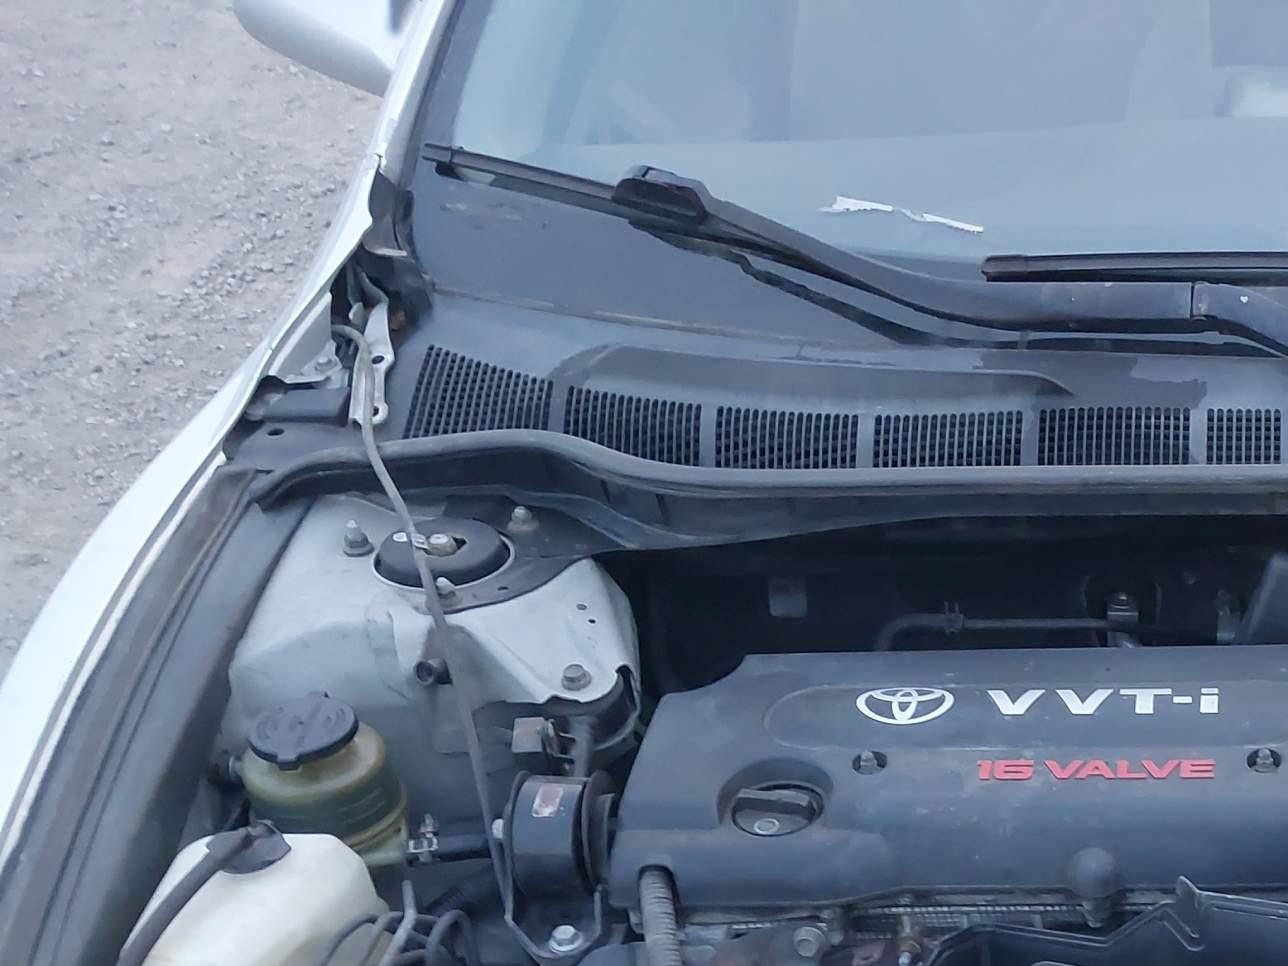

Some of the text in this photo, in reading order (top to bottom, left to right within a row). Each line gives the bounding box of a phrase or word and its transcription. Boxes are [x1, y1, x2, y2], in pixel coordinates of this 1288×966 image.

[987, 687, 1220, 716] VVT-i
[977, 758, 1216, 781] 16 VALVE
